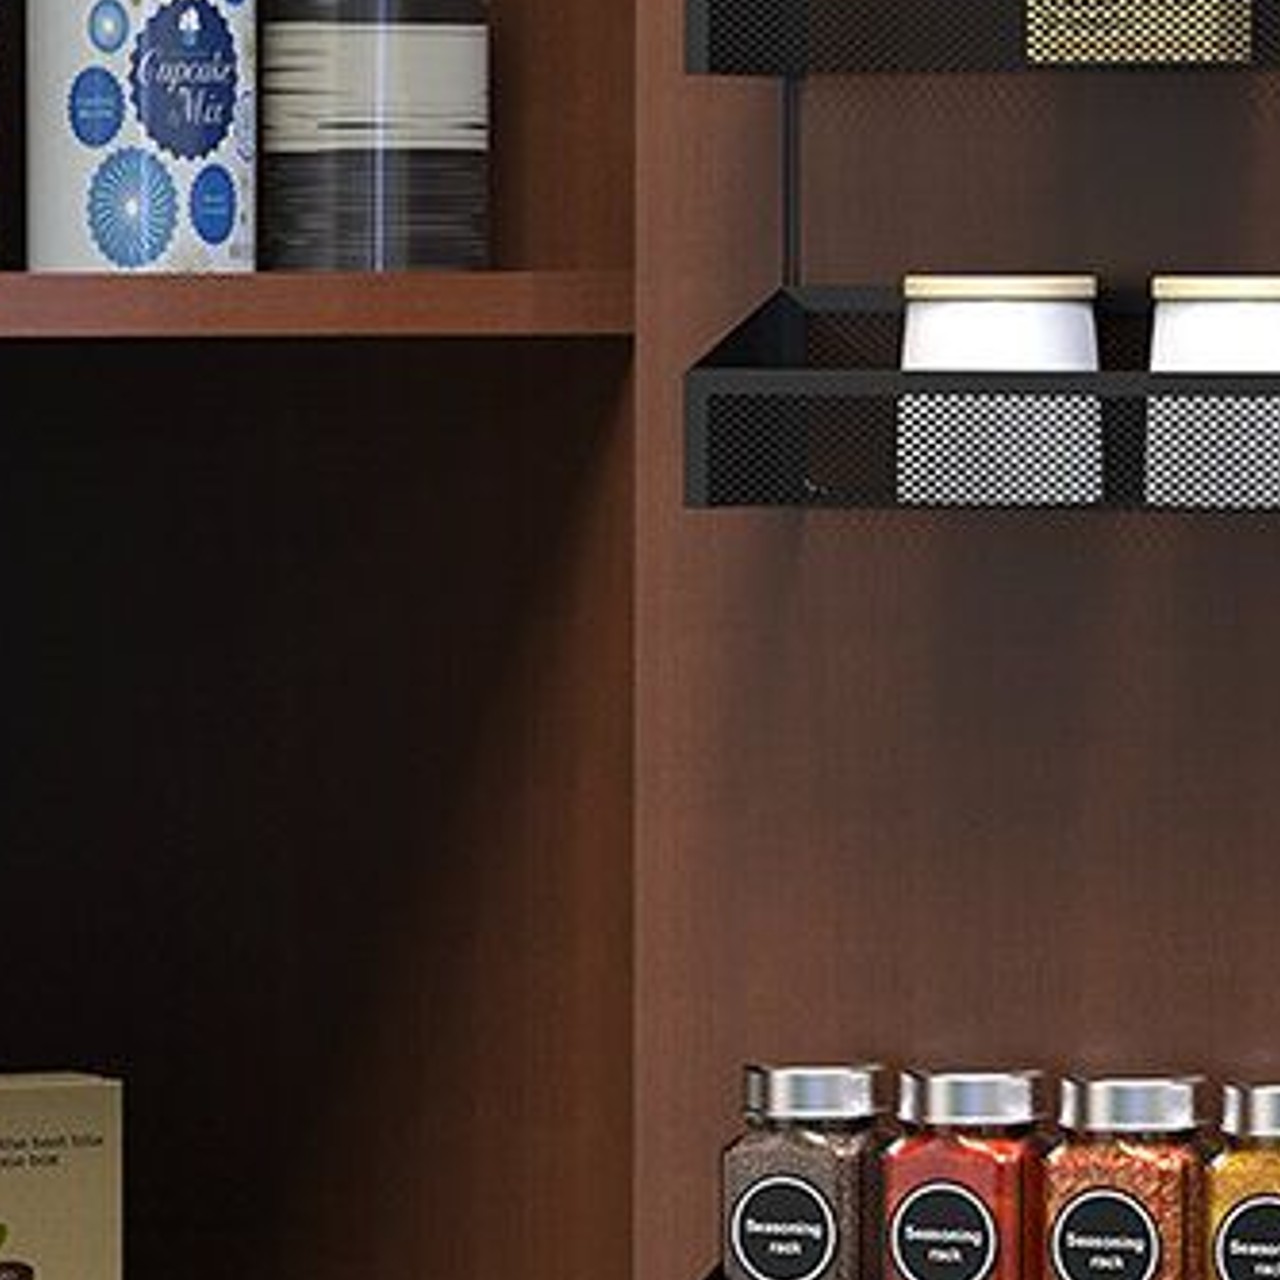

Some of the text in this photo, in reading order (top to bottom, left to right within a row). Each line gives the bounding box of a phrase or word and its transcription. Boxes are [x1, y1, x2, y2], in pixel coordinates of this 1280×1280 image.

[745, 1218, 823, 1240] Seasoning
[904, 1224, 983, 1247] Seasoning
[768, 1241, 802, 1255] rack
[1065, 1231, 1146, 1254] Seasoning
[927, 1247, 962, 1263] rack
[1089, 1255, 1124, 1270] rack
